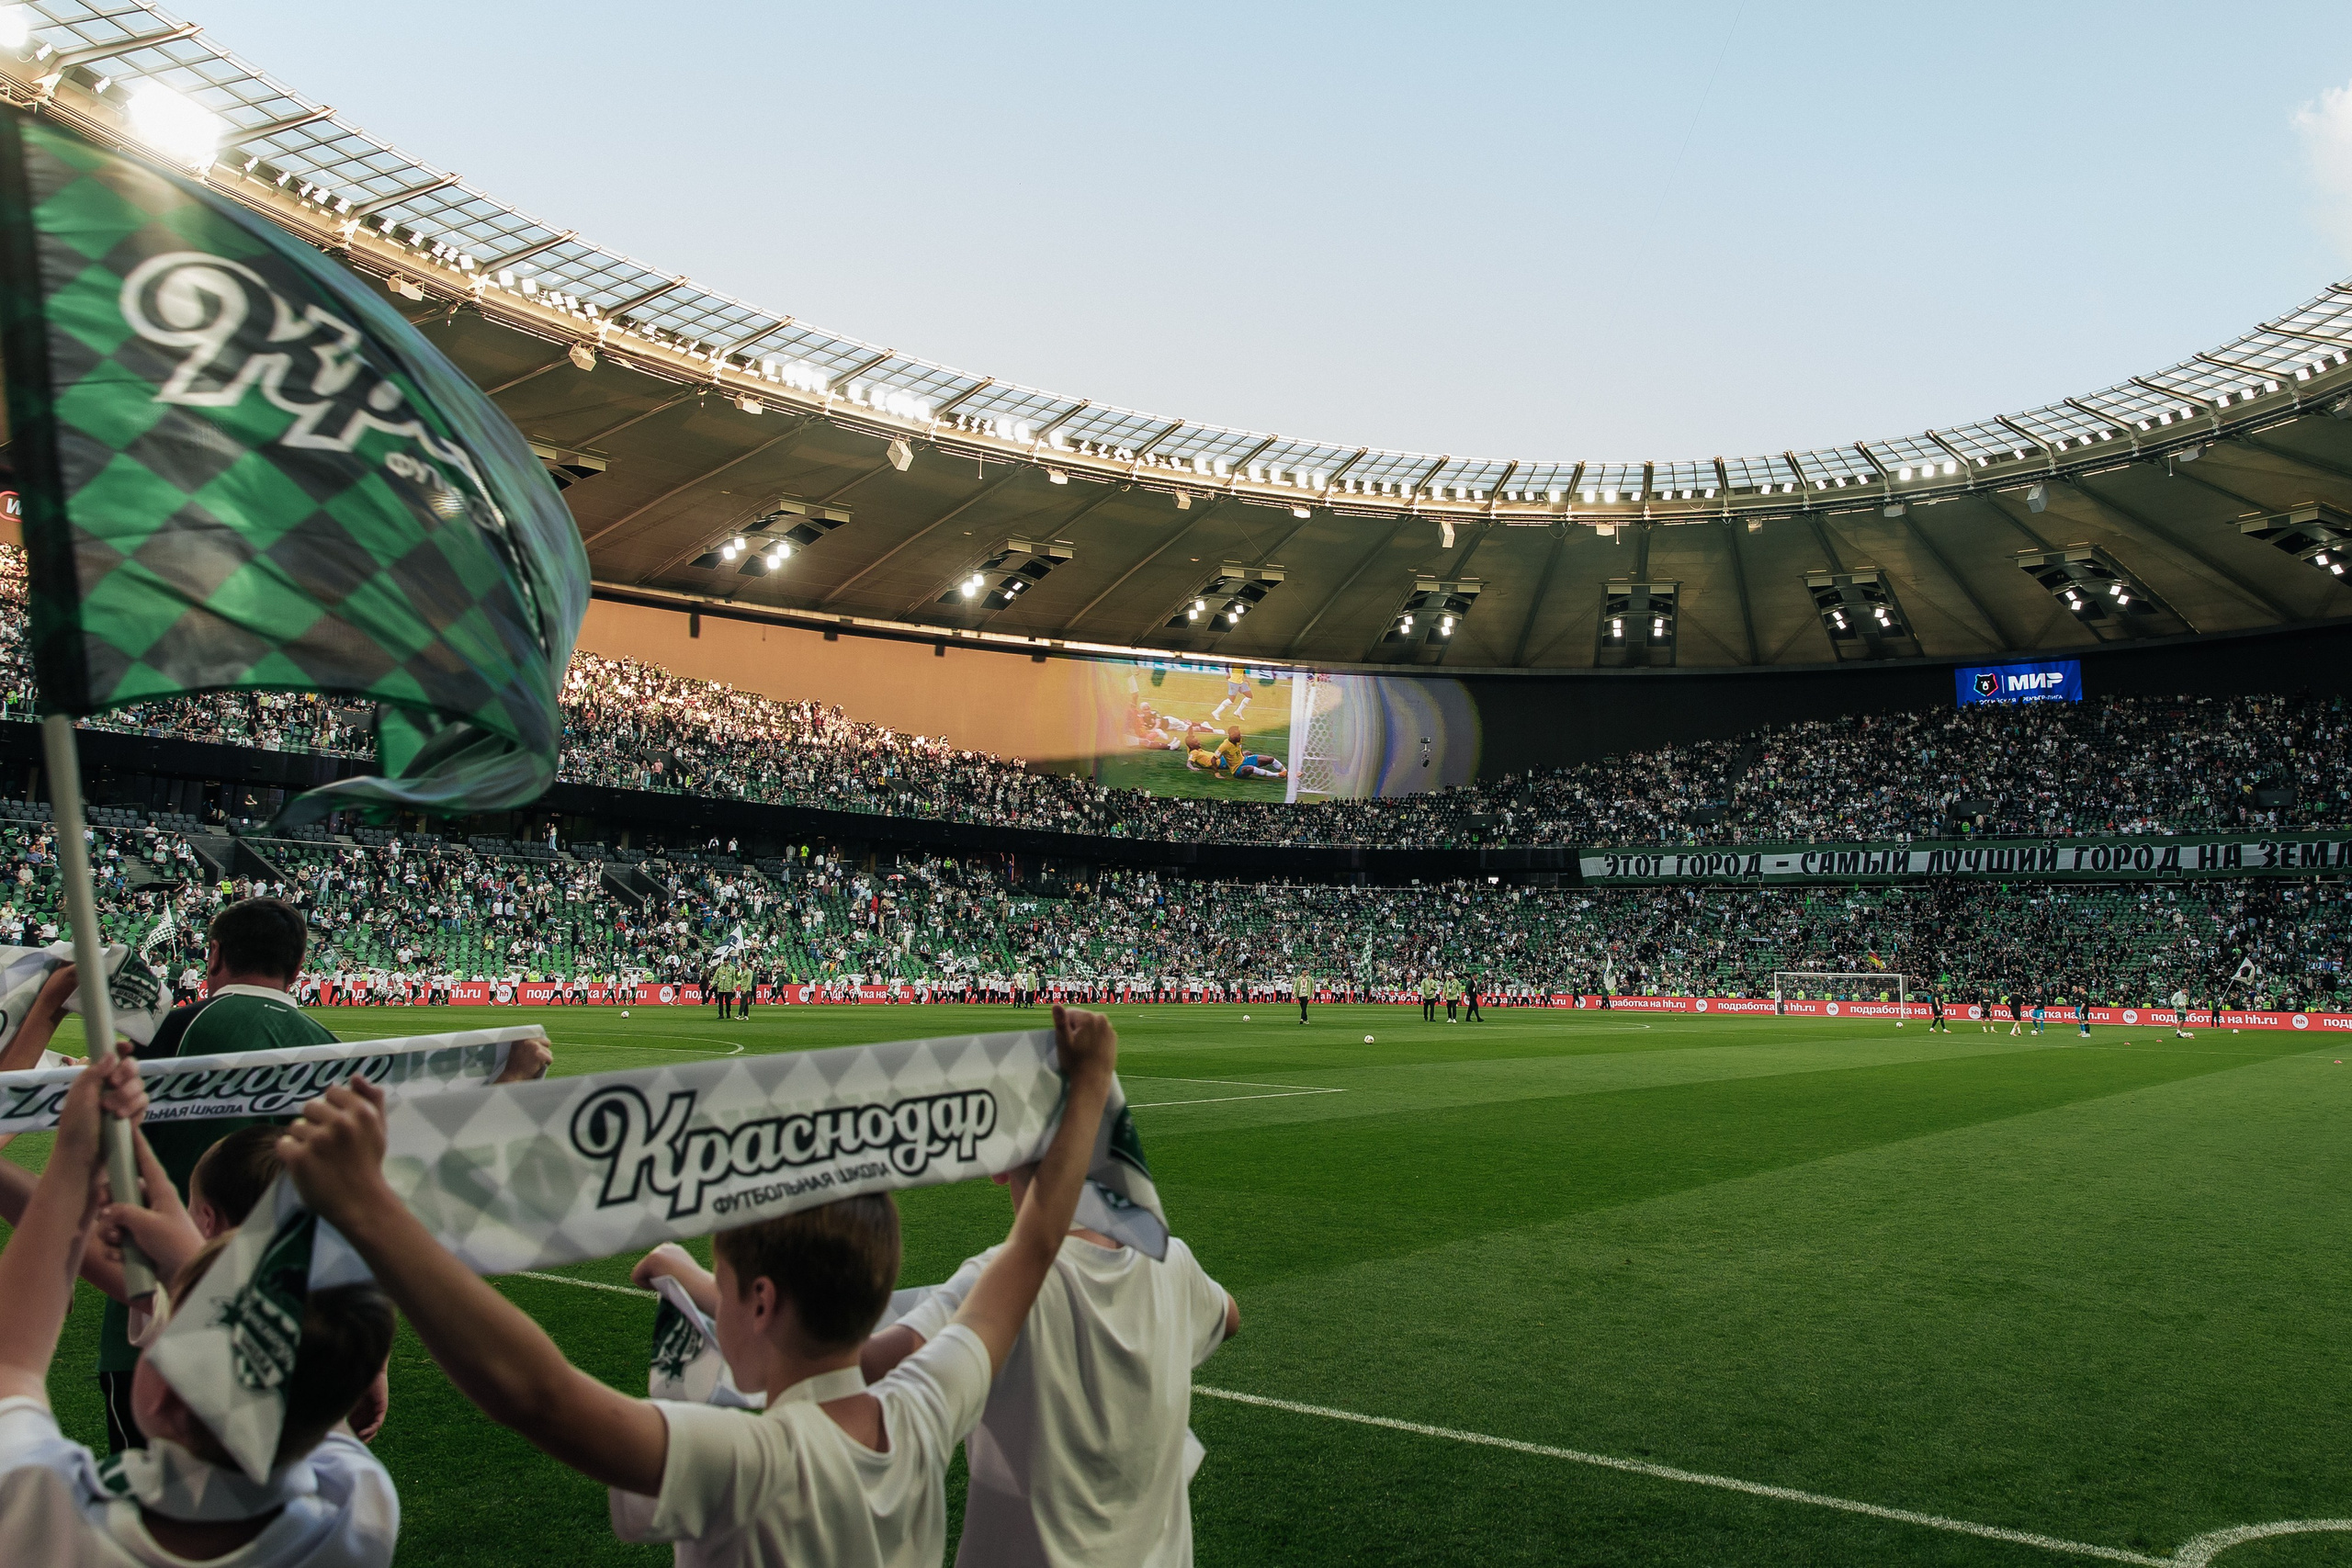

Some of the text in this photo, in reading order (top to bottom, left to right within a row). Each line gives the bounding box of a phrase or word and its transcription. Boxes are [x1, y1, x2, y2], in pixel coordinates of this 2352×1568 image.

[2007, 672, 2064, 691] МИР
[1603, 852, 1664, 878] ЭТОТ
[1676, 852, 1764, 883] ГОРОД
[1801, 843, 1911, 875] САМЫЙ
[1925, 840, 2060, 876] ЛУЧШИЙ
[2073, 842, 2183, 878] ГОРОД
[2198, 842, 2243, 872] НА
[1662, 999, 1686, 1009] hh.ru
[1717, 1001, 1775, 1011] подработка
[1790, 1002, 1815, 1012] hh.ru
[1914, 1007, 1928, 1015] на
[2227, 1016, 2244, 1024] на
[2245, 1014, 2278, 1025] hh.ru
[190, 1104, 243, 1115] ШКОЛА
[570, 1084, 998, 1221] Краснодар
[712, 1161, 892, 1215] ФУТБОЛЬНАЯ ШКОЛА
